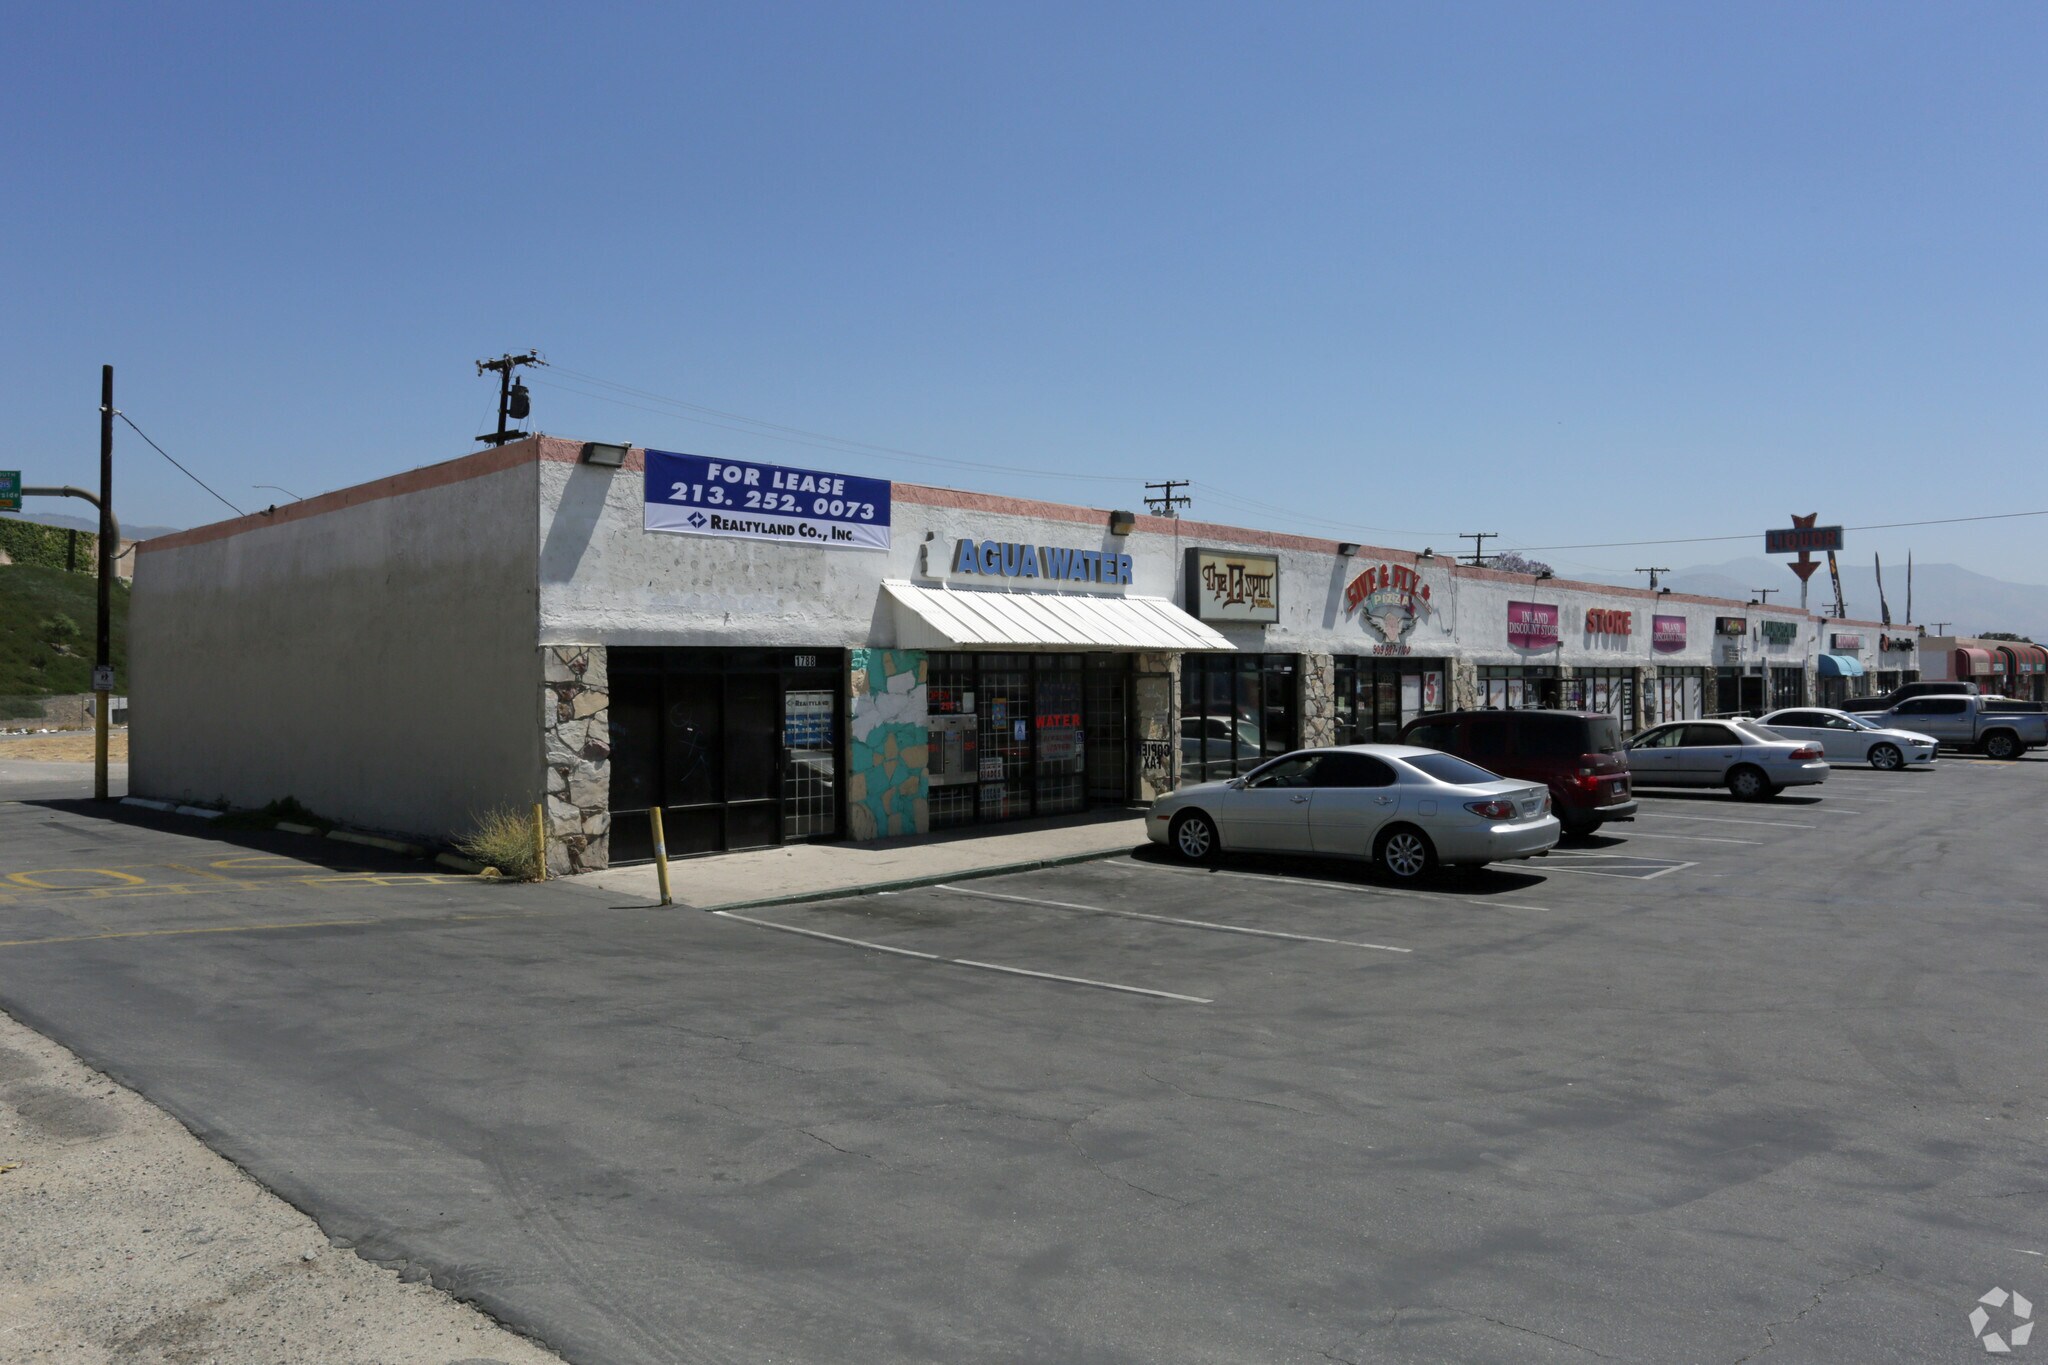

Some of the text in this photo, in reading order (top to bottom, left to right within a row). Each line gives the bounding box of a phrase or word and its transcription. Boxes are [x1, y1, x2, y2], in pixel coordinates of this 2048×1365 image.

[707, 463, 845, 497] FOR LEASE
[668, 482, 875, 520] 213. 252. 0073
[710, 514, 795, 536] REALTYLAND
[831, 525, 855, 542] INC.
[1768, 530, 1837, 551] LIQUOR
[952, 538, 1134, 585] AGUA WATER
[1202, 562, 1227, 602] The
[1379, 564, 1390, 589] &
[1373, 593, 1410, 607] PIZZA
[1521, 611, 1548, 625] INLAND
[1586, 607, 1632, 635] STORE
[1662, 622, 1680, 632] INLAND
[1509, 623, 1558, 636] DISCOUNT STORE
[1837, 635, 1859, 648] LIQUOR
[795, 656, 816, 667] 1788
[1035, 713, 1081, 729] WATER
